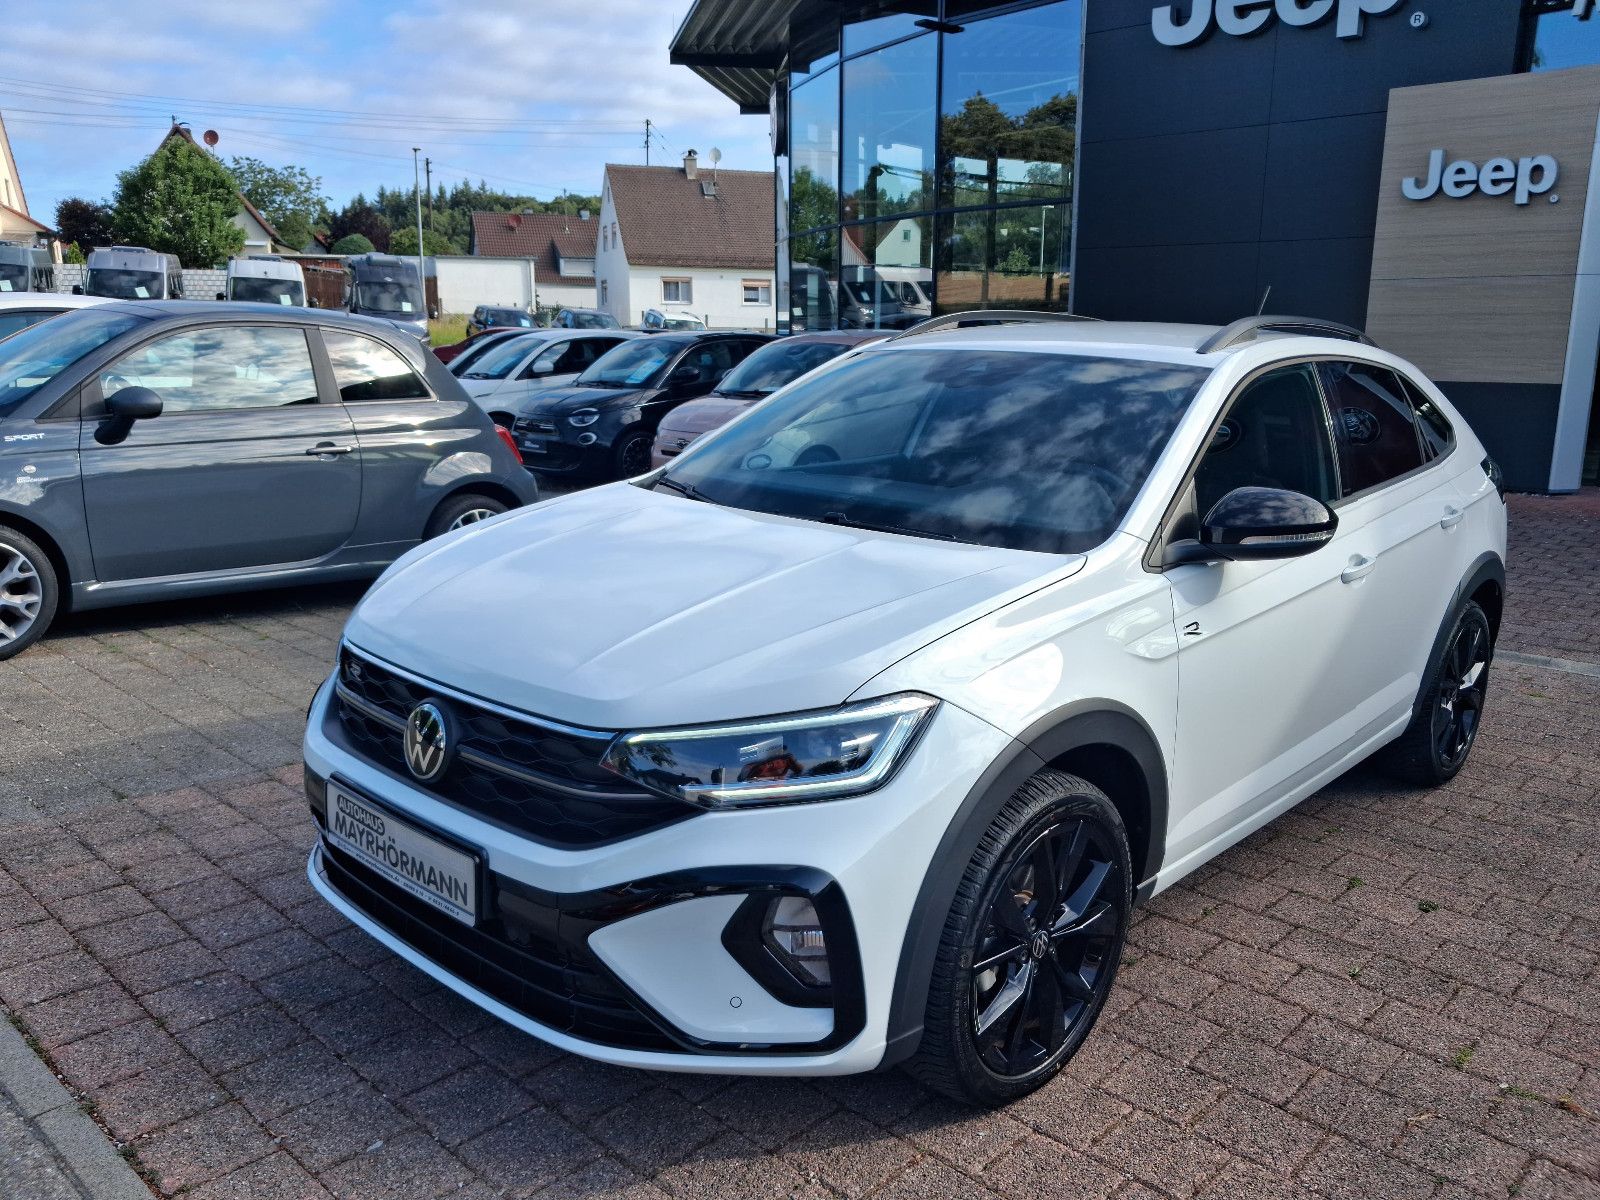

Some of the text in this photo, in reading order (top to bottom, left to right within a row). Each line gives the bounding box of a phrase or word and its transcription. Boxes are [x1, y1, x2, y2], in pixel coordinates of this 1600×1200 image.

[1402, 149, 1557, 205] Jeep
[4, 433, 45, 442] SPORT
[338, 796, 384, 834] AUTOHAUS
[335, 811, 467, 907] MAYRHÖRMANN
